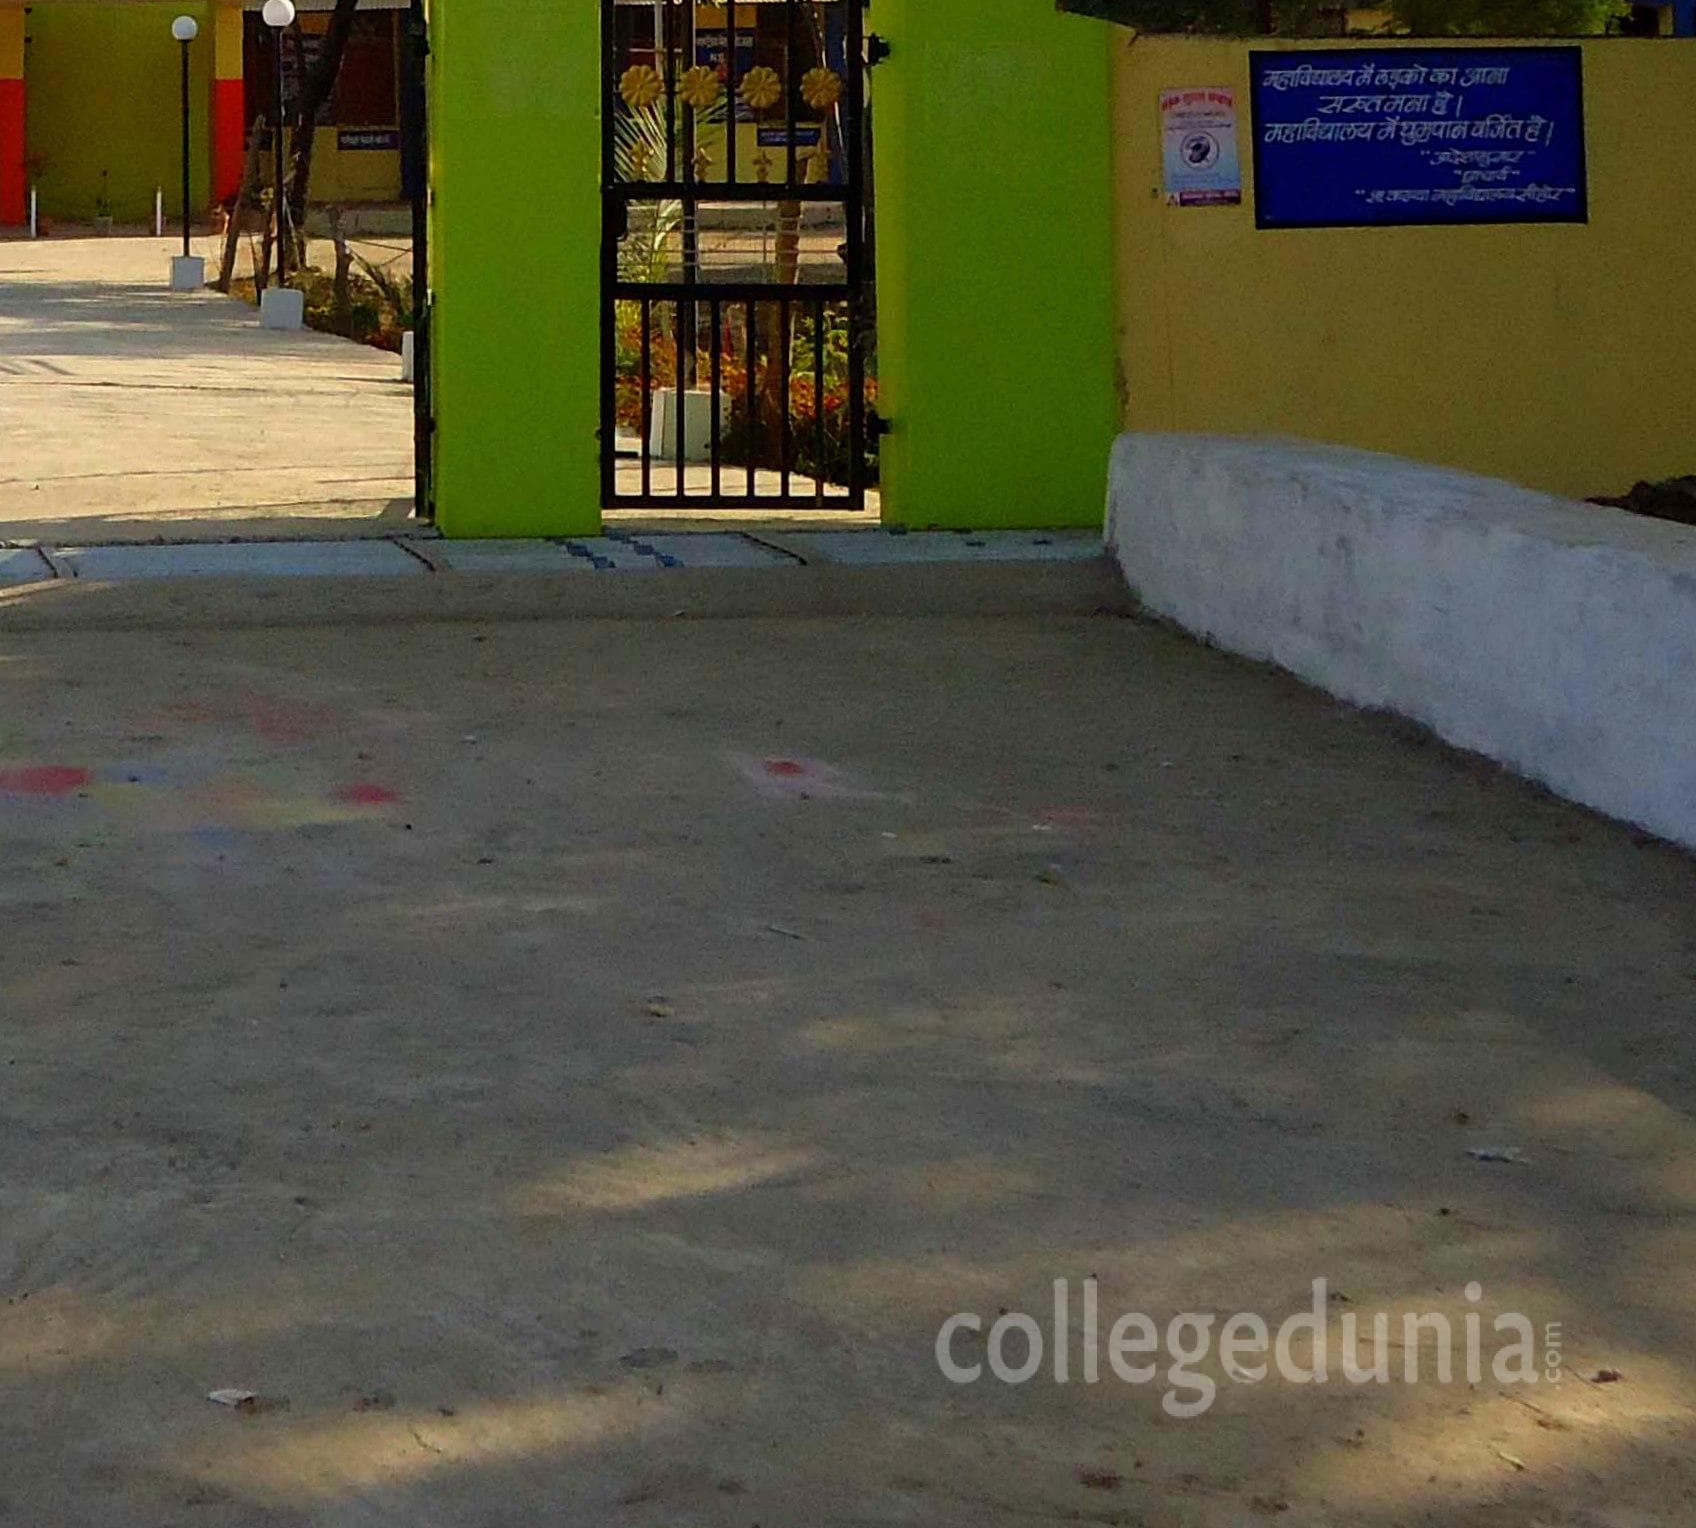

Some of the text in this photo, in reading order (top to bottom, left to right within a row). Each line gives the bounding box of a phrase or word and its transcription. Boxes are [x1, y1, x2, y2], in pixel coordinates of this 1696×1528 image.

[1263, 65, 1354, 90] महाविद्यालय
[1430, 67, 1458, 85] का
[1460, 67, 1510, 87] आना
[1384, 94, 1431, 113] मना
[1264, 117, 1376, 143] महाविद्यालय
